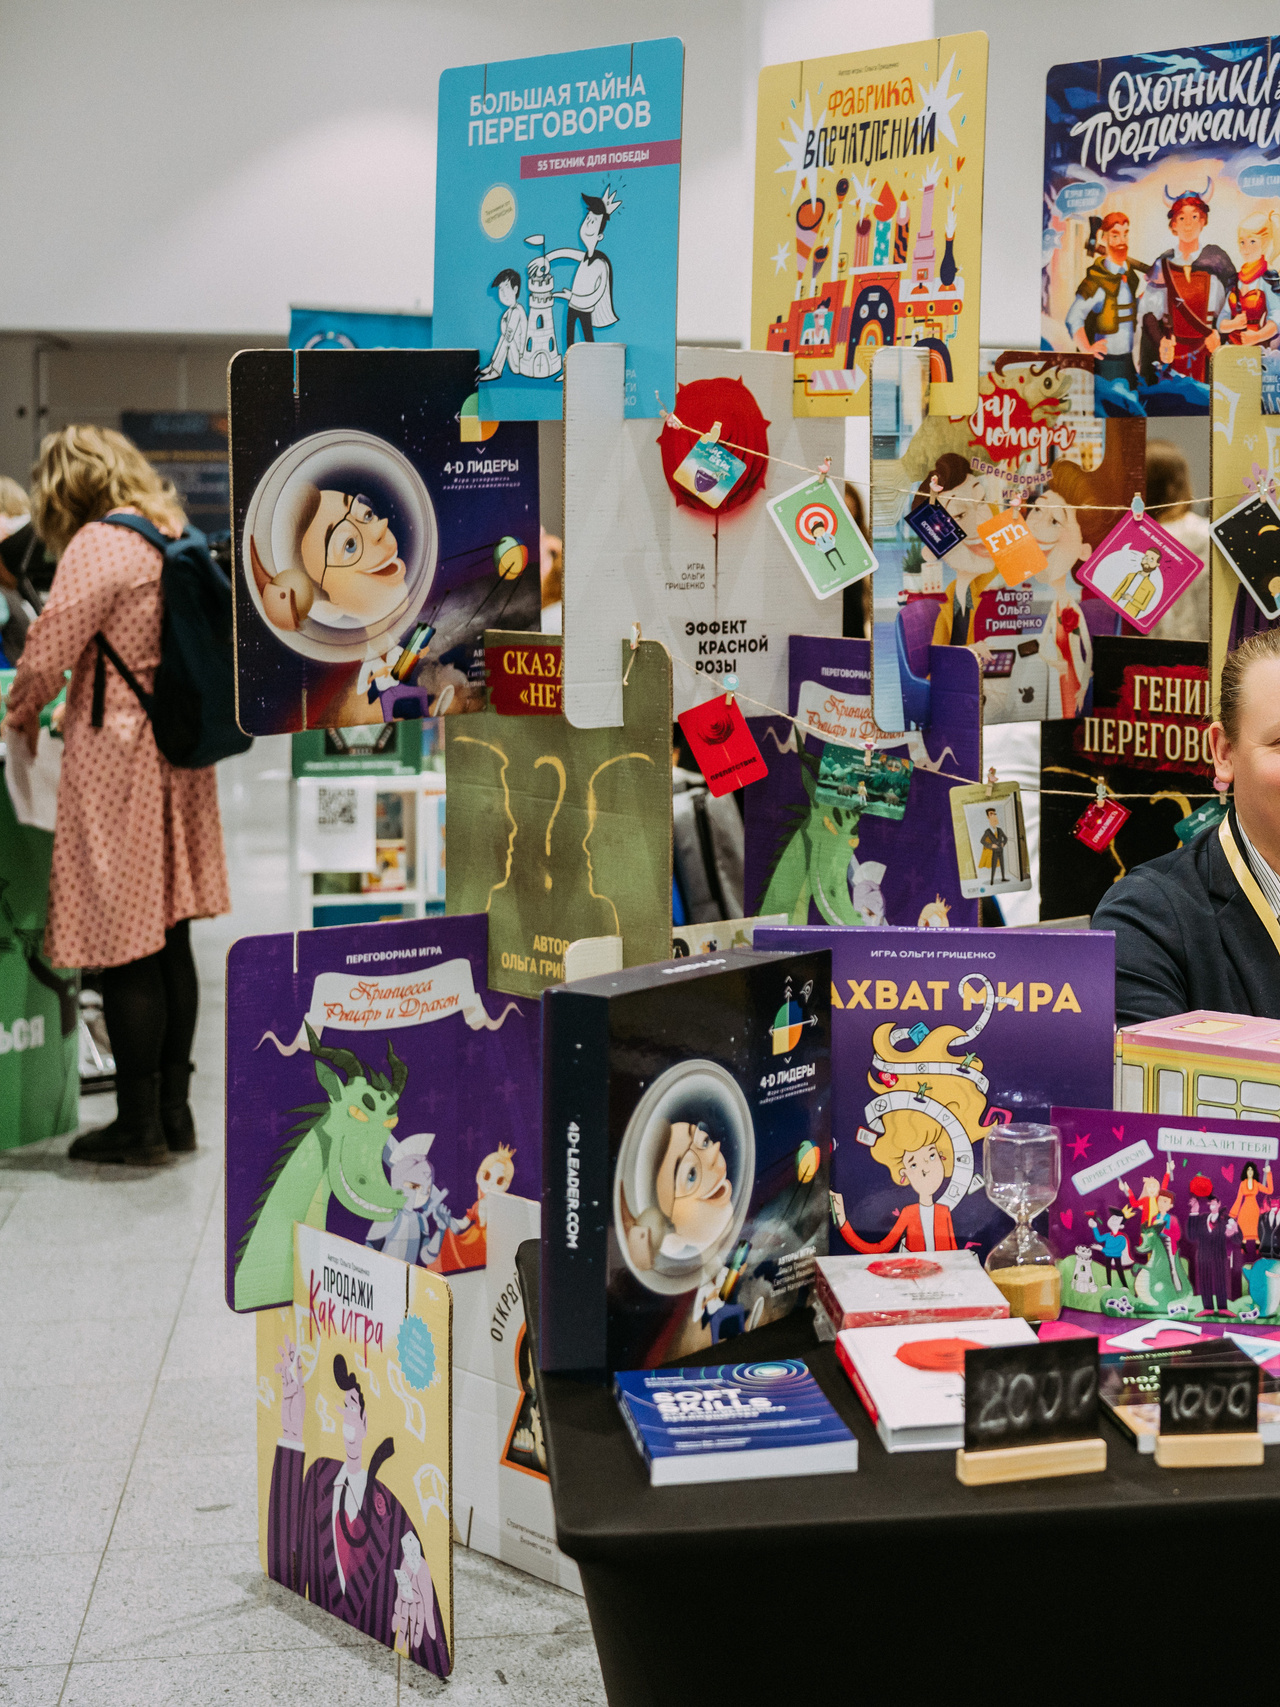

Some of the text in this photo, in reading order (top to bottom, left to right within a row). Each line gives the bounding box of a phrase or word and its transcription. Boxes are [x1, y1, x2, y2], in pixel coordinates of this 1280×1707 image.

[470, 72, 646, 116] БОЛЬШАЯ ТАЙНА
[468, 100, 651, 147] ПЕРЕГОВОРОВ
[537, 149, 650, 171] 55 ТЕХНИК ДЛЯ ПОБЕДЫ
[986, 422, 1076, 466] юмора
[467, 459, 519, 474] ЛИДЕРЫ
[970, 458, 1054, 485] Переговорная
[665, 582, 705, 590] ГРИЩЕНКО
[996, 590, 1034, 602] Автор:
[997, 604, 1031, 617] Ольга
[685, 620, 747, 636] ЭФФЕКТ
[985, 617, 1043, 632] Грищенко
[698, 635, 768, 655] КРАСНОЙ
[695, 659, 737, 674] РОЗЫ
[710, 757, 758, 782] ПРЕПЯТСТВИЕ
[346, 945, 442, 965] ПЕРЕГОВОРНАЯ ИГРА
[501, 952, 537, 974] ОЛЬГА
[870, 950, 996, 961] ИГРА ОЛЬГИ ГРИЩЕНКО
[349, 980, 434, 1006] Принцесса
[963, 981, 1082, 1013] МИРА
[323, 994, 459, 1027] Рыцарь Дракон
[759, 1063, 816, 1089] 4-D ЛИДЕРЫ
[1164, 1134, 1272, 1154] МЫ ЖДАЛИ ТЕБЯ!
[566, 1121, 581, 1249] 4D-LEADER.COM
[323, 1265, 373, 1311] ПРОДАЖИ
[309, 1269, 337, 1342] Как
[341, 1308, 383, 1368] игра
[652, 1388, 742, 1404] SOFT
[656, 1396, 773, 1415] SKILLS
[977, 1364, 1098, 1431] 2000
[1164, 1381, 1251, 1421] 1000
